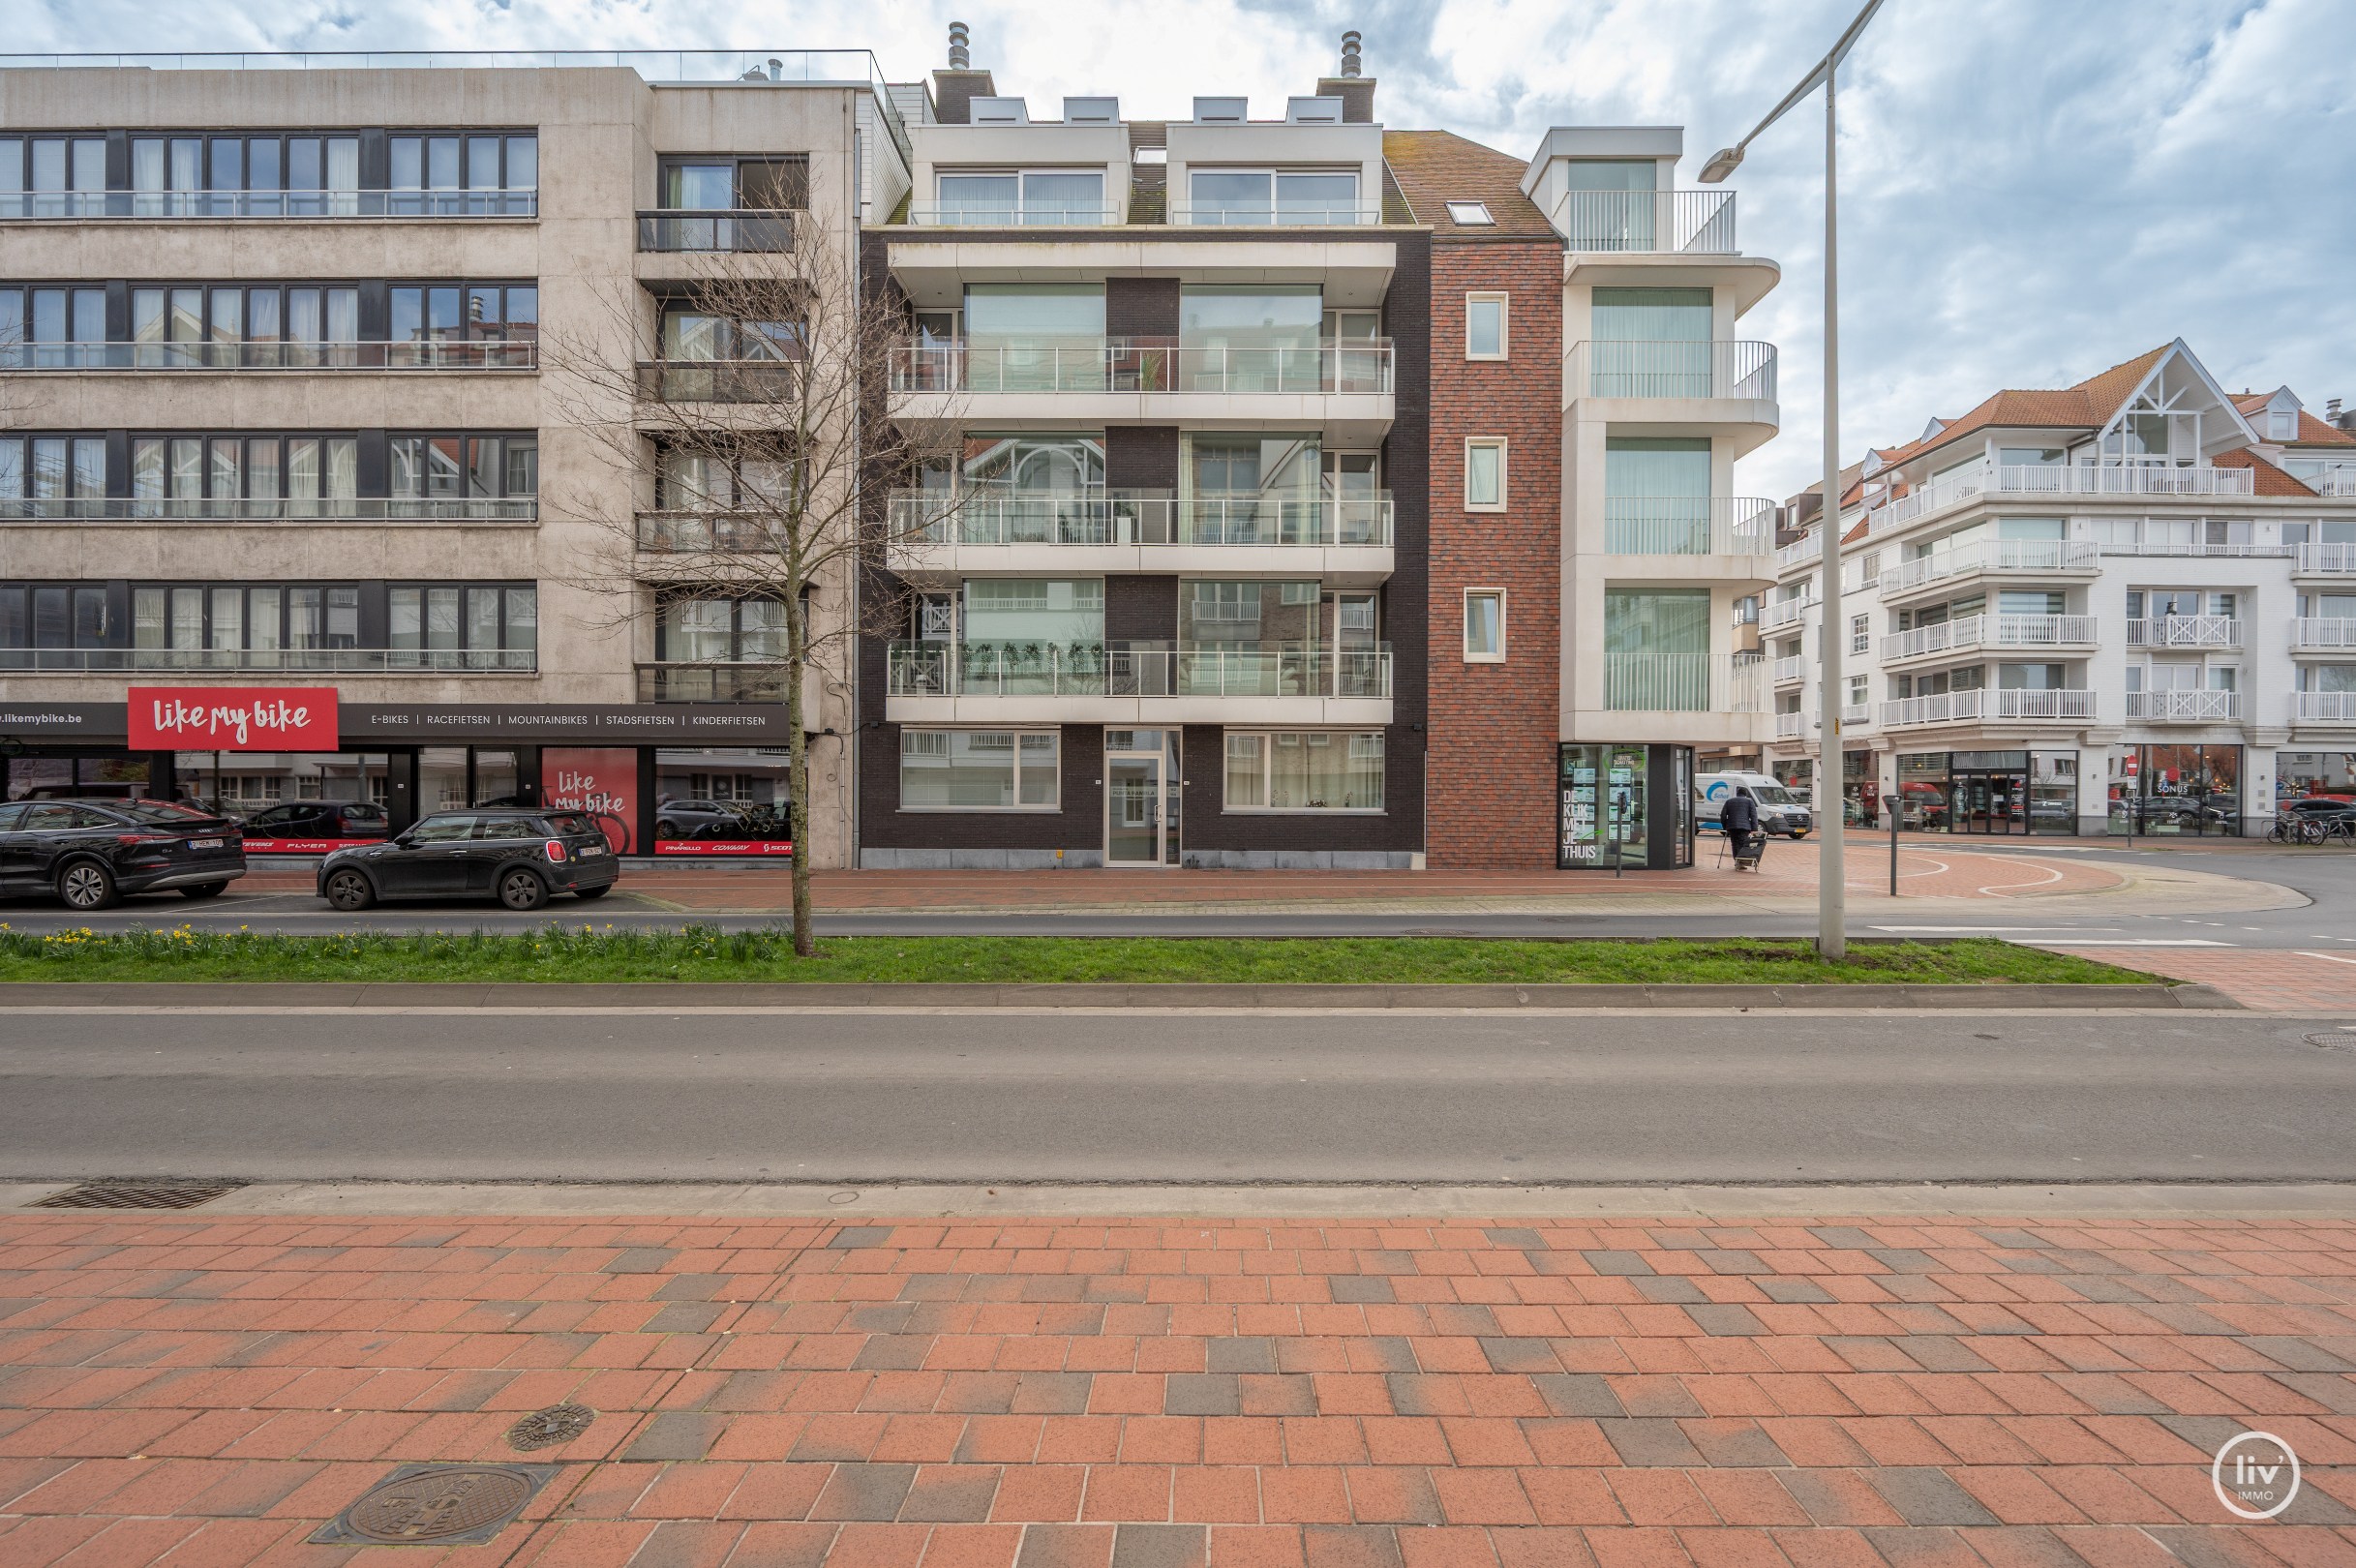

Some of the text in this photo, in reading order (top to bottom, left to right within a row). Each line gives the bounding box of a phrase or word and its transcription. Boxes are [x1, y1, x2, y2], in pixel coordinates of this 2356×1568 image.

[254, 699, 311, 733] bike
[371, 714, 766, 726] E-BIKES RACEFIETSEN MOUNTAINBIKES STADSFIETSEN KINDERFIETSEN
[1562, 790, 1578, 803] DE
[2157, 785, 2188, 794] SONUS
[586, 792, 625, 815] bike
[1563, 803, 1588, 817] KLIK
[1563, 818, 1587, 830] MET
[1563, 831, 1577, 845] JE
[1562, 845, 1596, 859] THUIS
